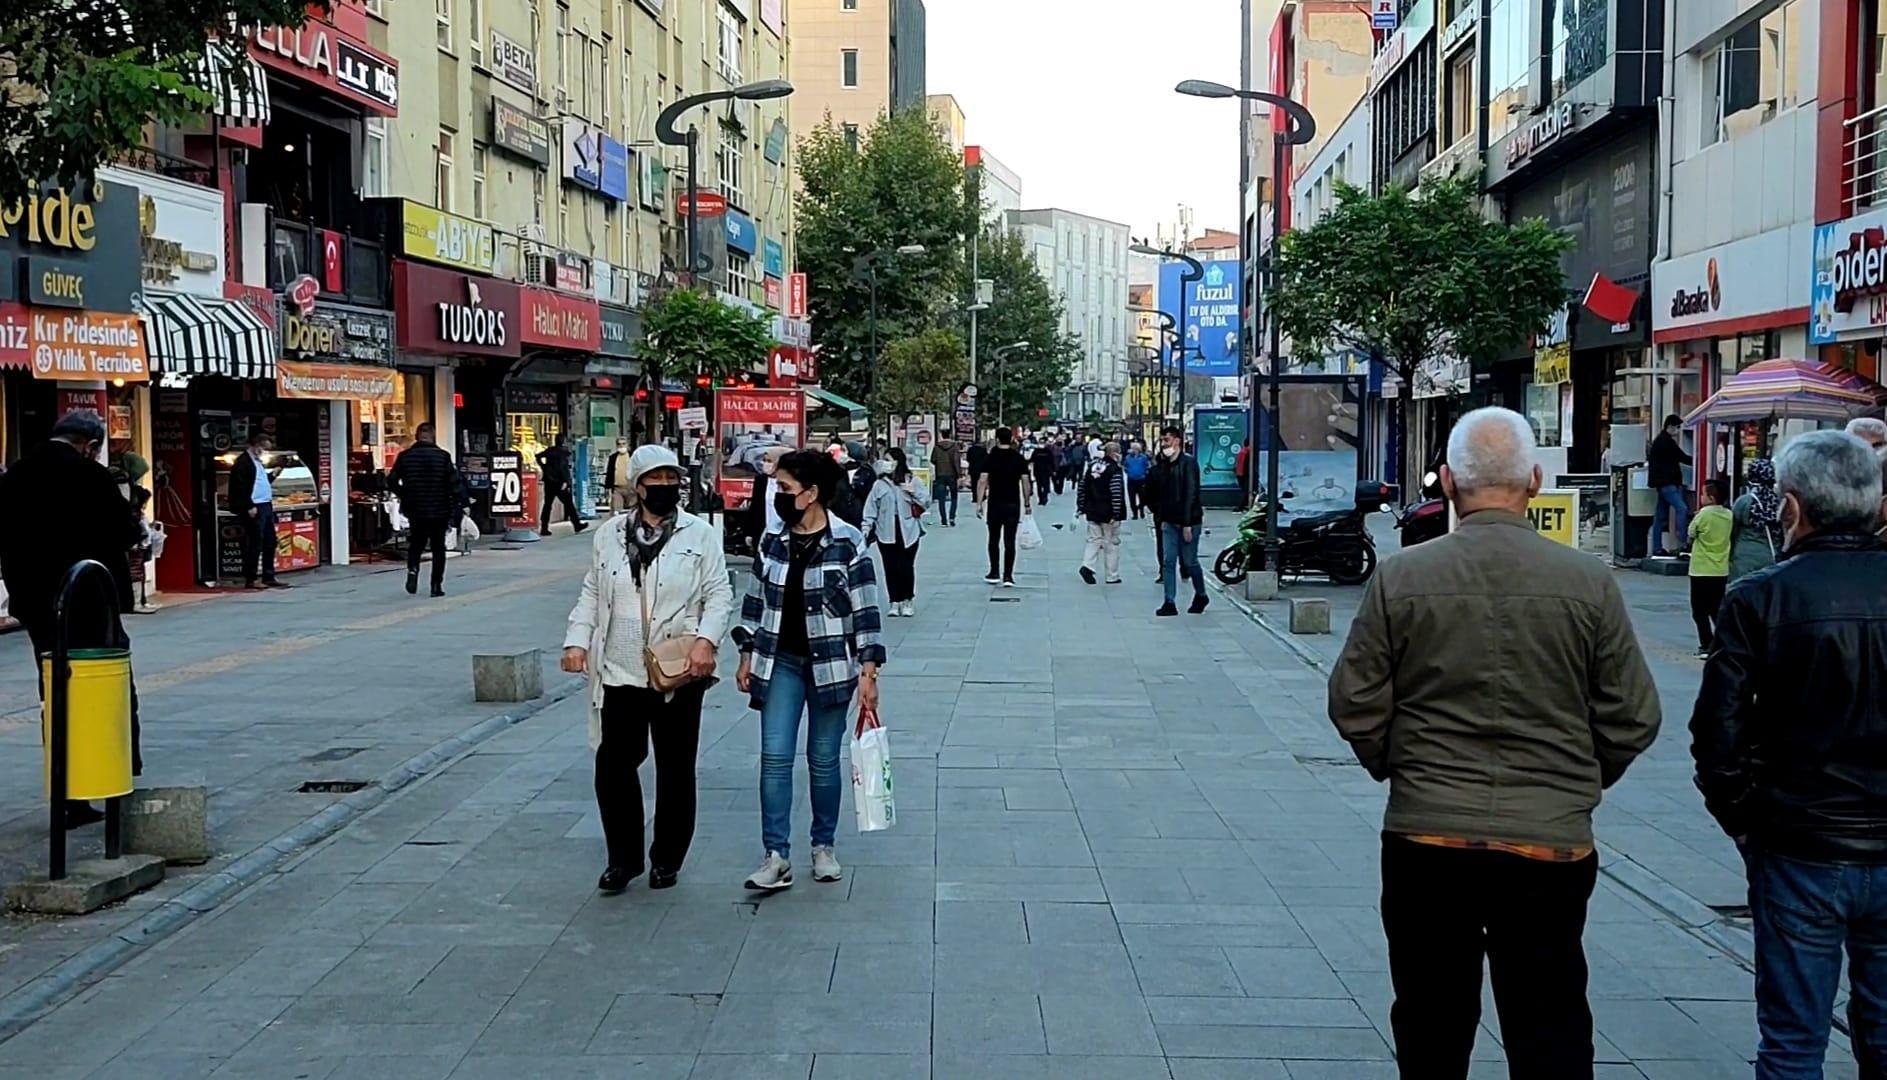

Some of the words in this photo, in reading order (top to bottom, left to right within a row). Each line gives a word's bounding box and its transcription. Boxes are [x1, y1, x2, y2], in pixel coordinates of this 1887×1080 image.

[504, 40, 533, 72] BETA
[435, 214, 491, 268] ABİYE
[43, 267, 83, 302] GÜVEÇ
[1196, 283, 1233, 301] fuzul
[439, 302, 505, 346] TUDORS
[562, 309, 588, 342] Mahir
[1189, 305, 1199, 316] EV
[1200, 305, 1209, 316] DE
[1200, 316, 1215, 327] OTO
[34, 314, 59, 342] Kır
[63, 316, 138, 348] Pidesinde
[54, 347, 86, 372] Yıllık
[89, 350, 143, 374] Tecrübe
[723, 400, 758, 411] HALICI
[762, 399, 797, 411] MAHİR
[490, 471, 520, 503] 70
[1527, 507, 1566, 531] NET
